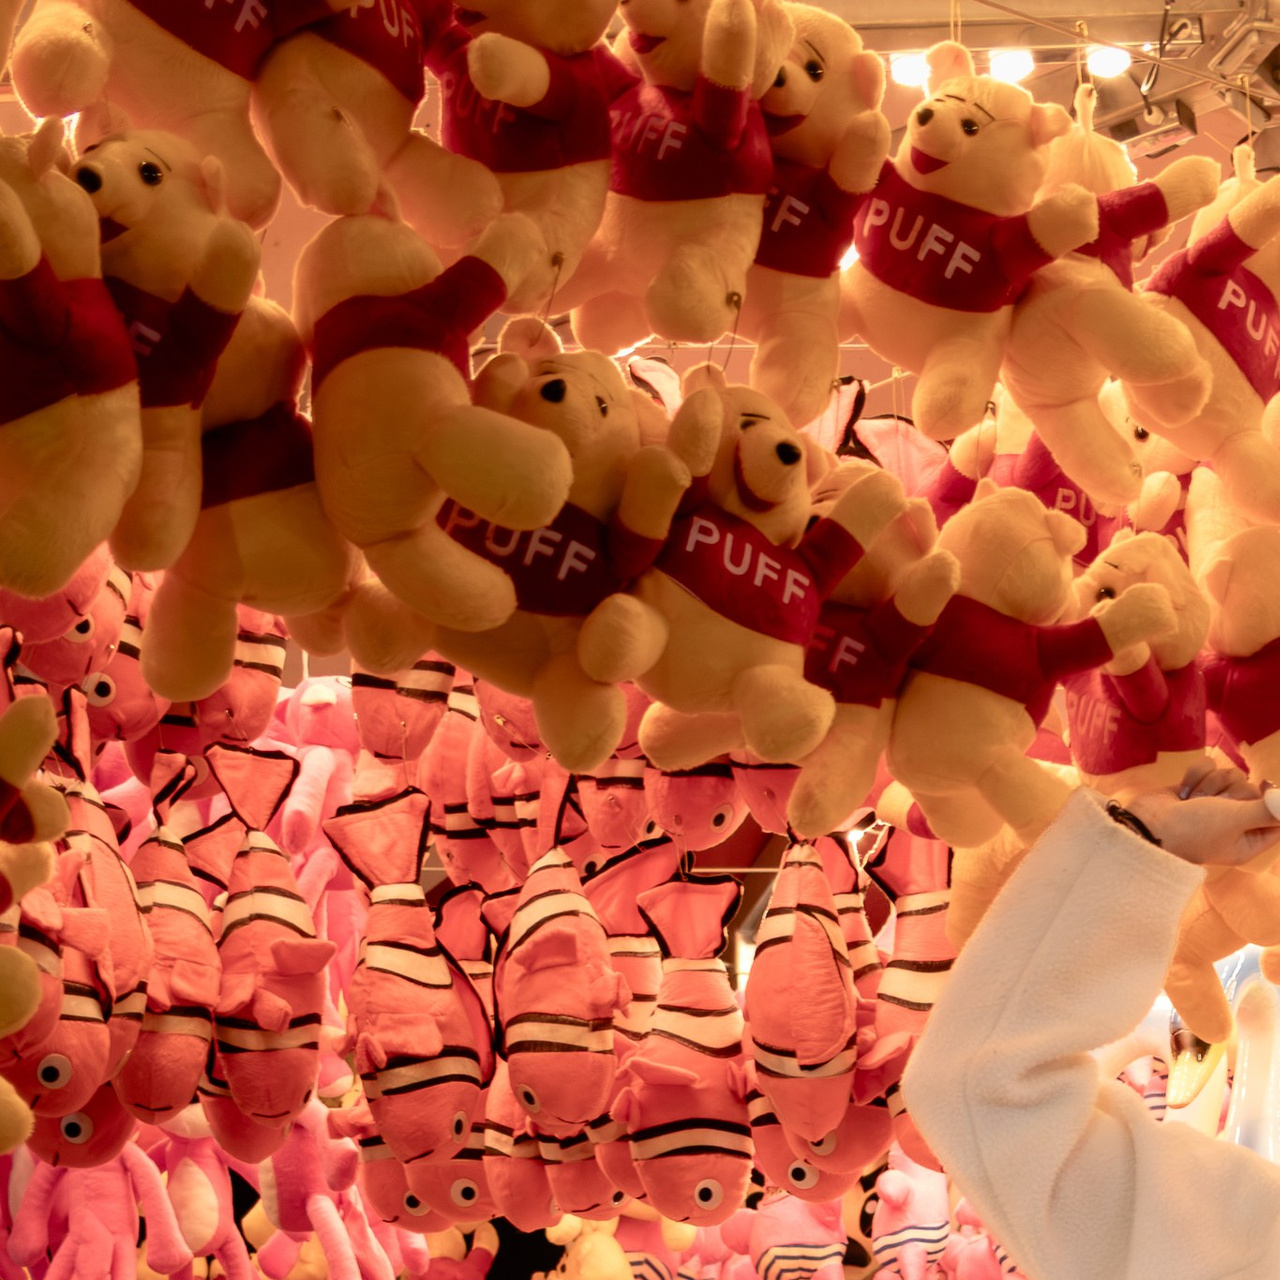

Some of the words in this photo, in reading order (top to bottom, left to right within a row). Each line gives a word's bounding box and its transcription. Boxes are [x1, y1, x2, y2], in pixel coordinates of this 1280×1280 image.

[862, 197, 982, 280] PUFF
[444, 503, 596, 581] PUFF
[685, 515, 811, 604] PUFF
